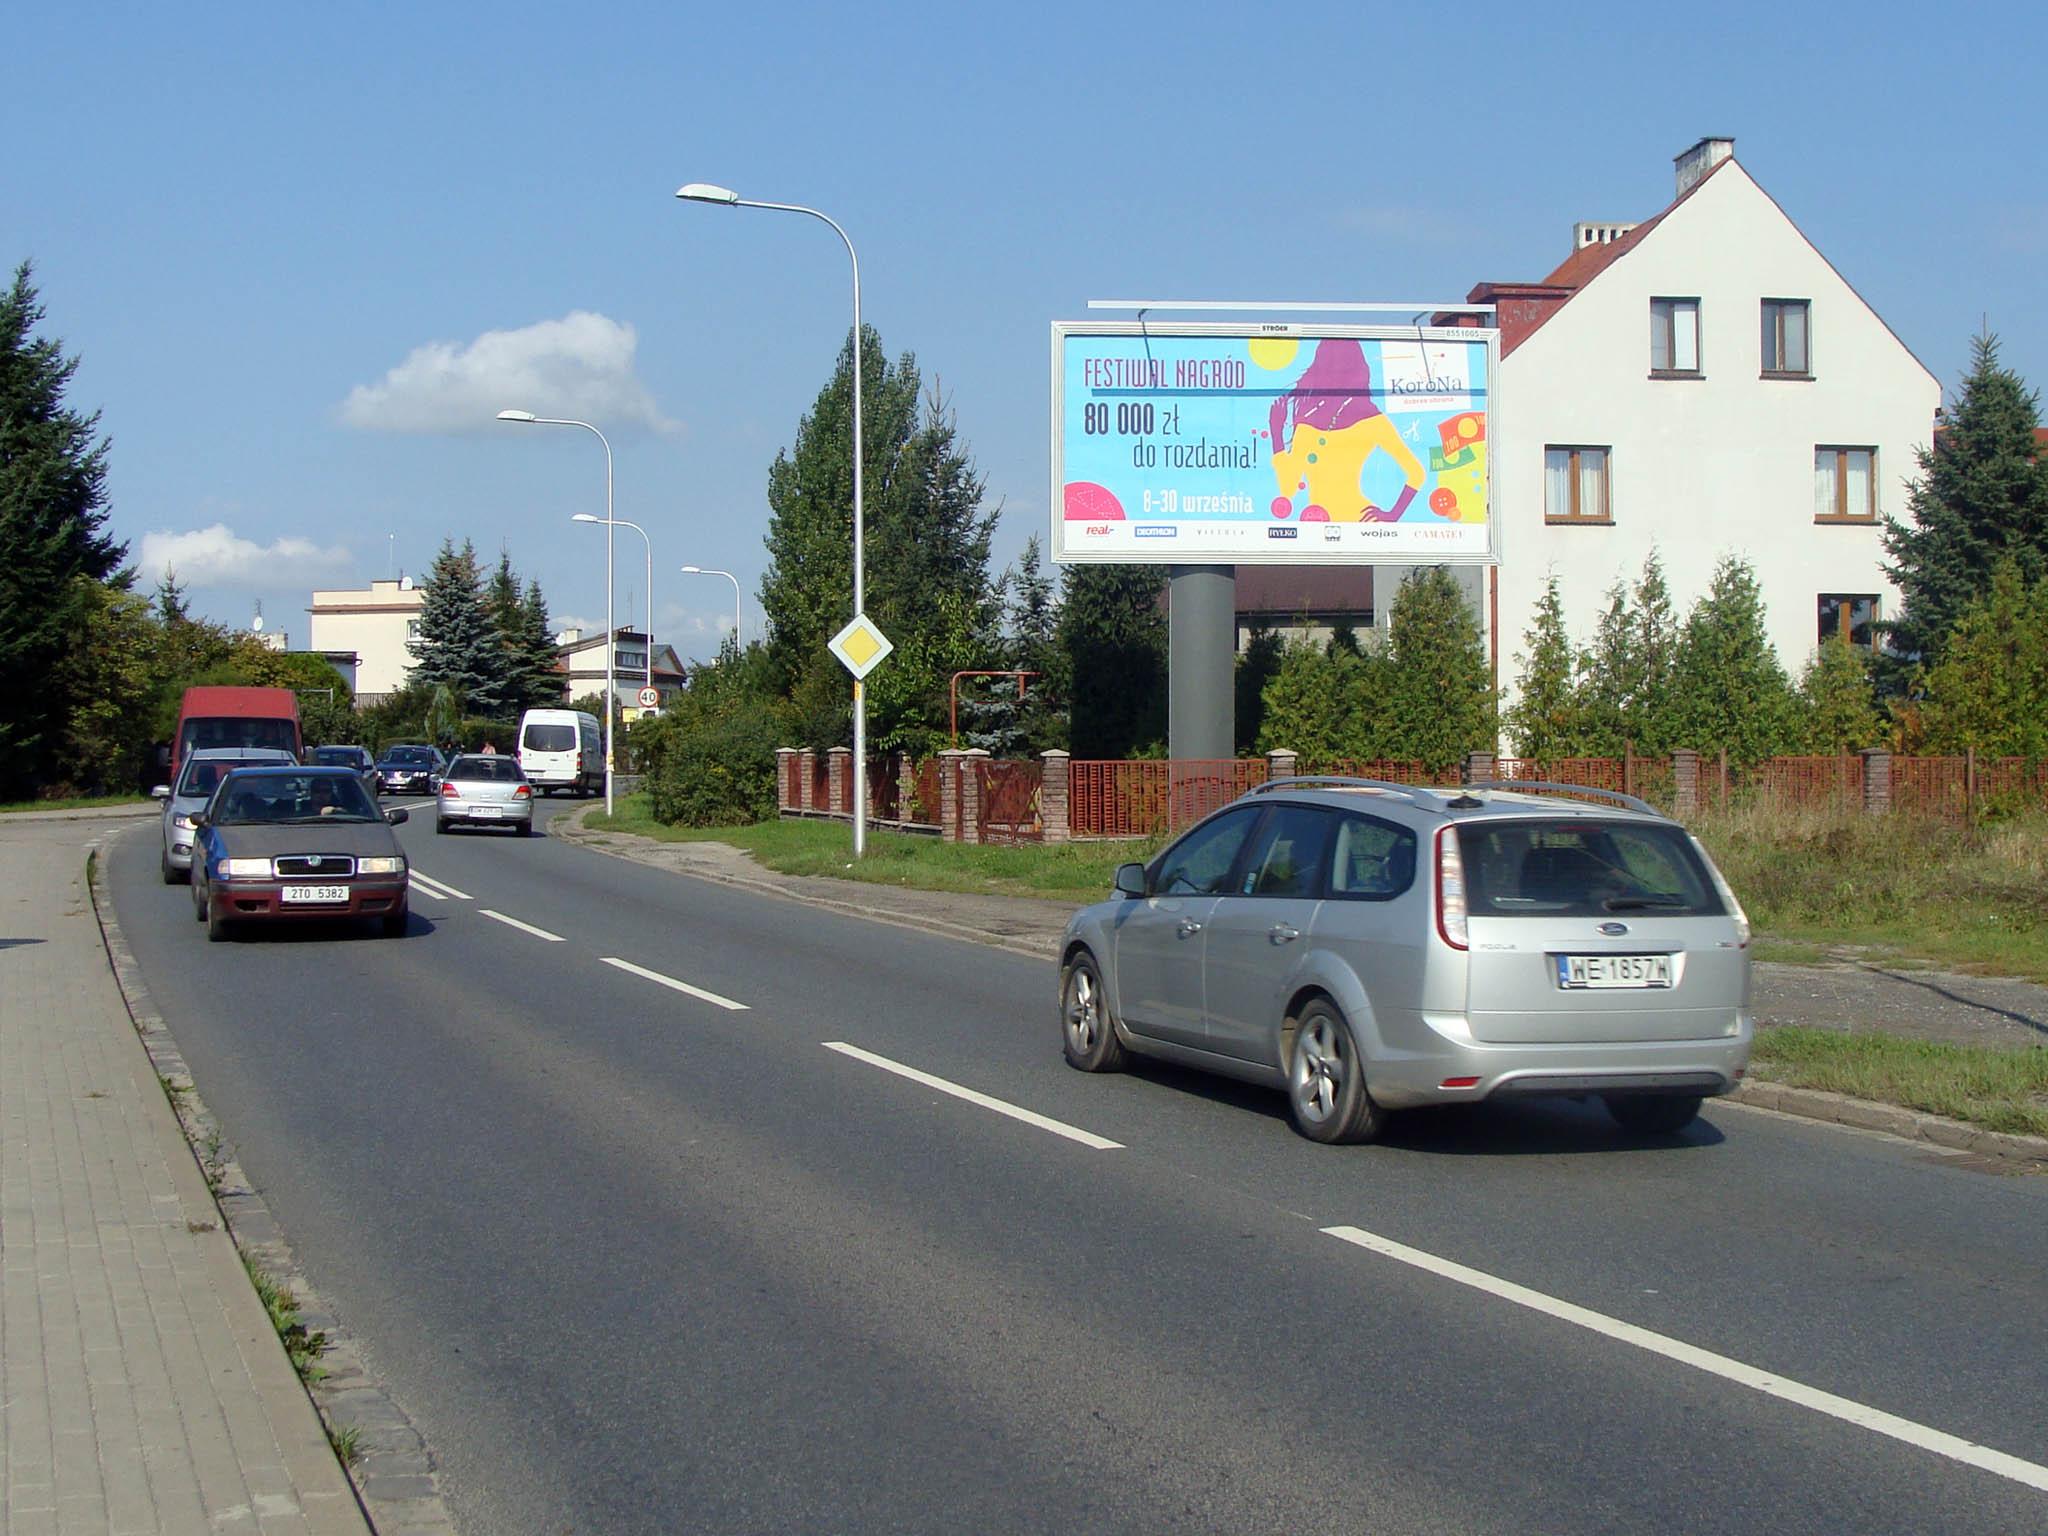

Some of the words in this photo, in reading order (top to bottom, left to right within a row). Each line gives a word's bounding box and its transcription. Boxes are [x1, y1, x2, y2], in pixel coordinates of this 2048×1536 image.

[1084, 358, 1169, 388] FESTIWAL
[1176, 355, 1246, 389] NAGRÓD
[1390, 376, 1463, 395] KoroNa
[1084, 402, 1109, 435] 80
[1118, 402, 1155, 435] 000
[1162, 403, 1182, 436] zł
[1134, 436, 1156, 468] do
[1164, 437, 1258, 469] rozdania!
[1182, 490, 1255, 514] września
[1361, 529, 1399, 539] wojas
[641, 692, 656, 702] 40
[318, 888, 344, 899] 5382
